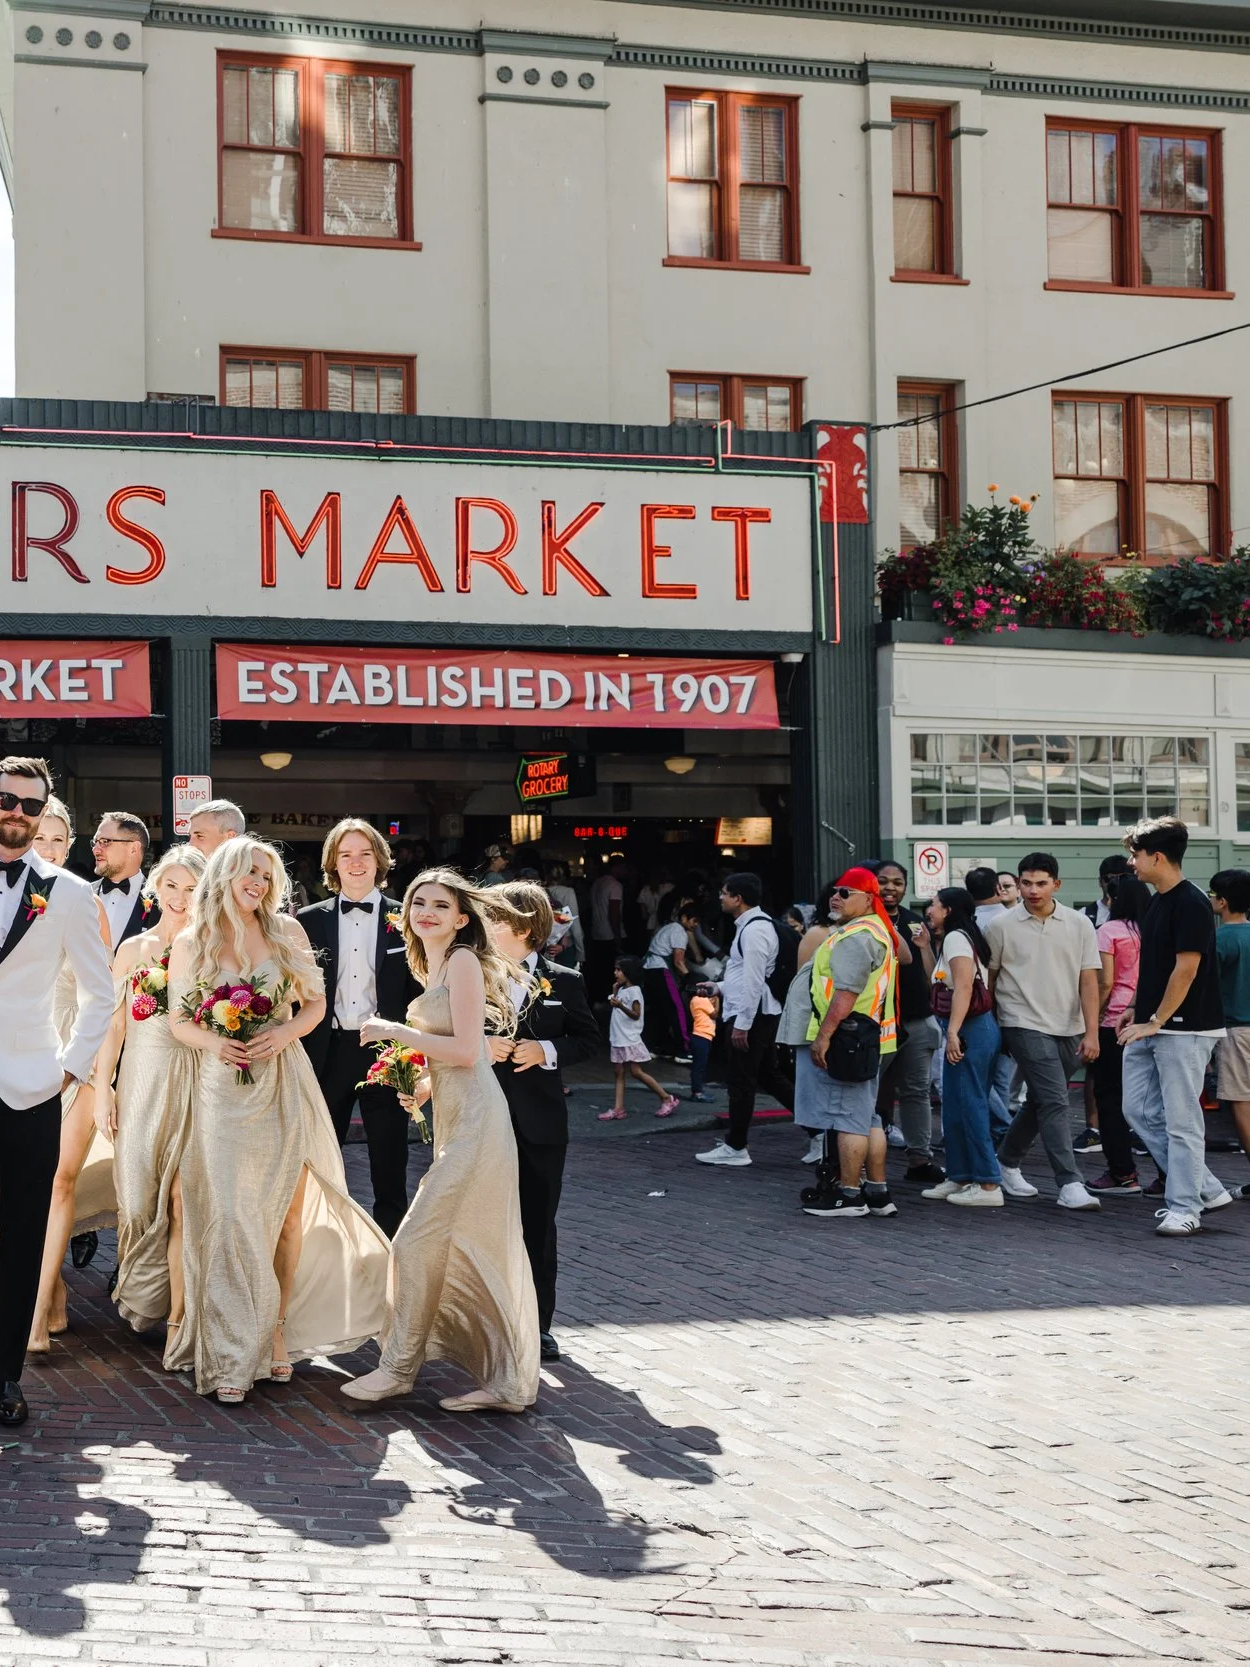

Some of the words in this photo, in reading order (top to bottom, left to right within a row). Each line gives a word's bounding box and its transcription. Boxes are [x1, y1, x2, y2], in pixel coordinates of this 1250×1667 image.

[260, 489, 772, 601] MARKET
[237, 661, 573, 710] ESTABLISHED
[585, 672, 632, 711] IN
[647, 673, 758, 715] 1907
[527, 759, 559, 778] ROTARY
[176, 778, 186, 787] NO
[522, 774, 568, 798] GROCERY
[179, 791, 206, 800] STOPS
